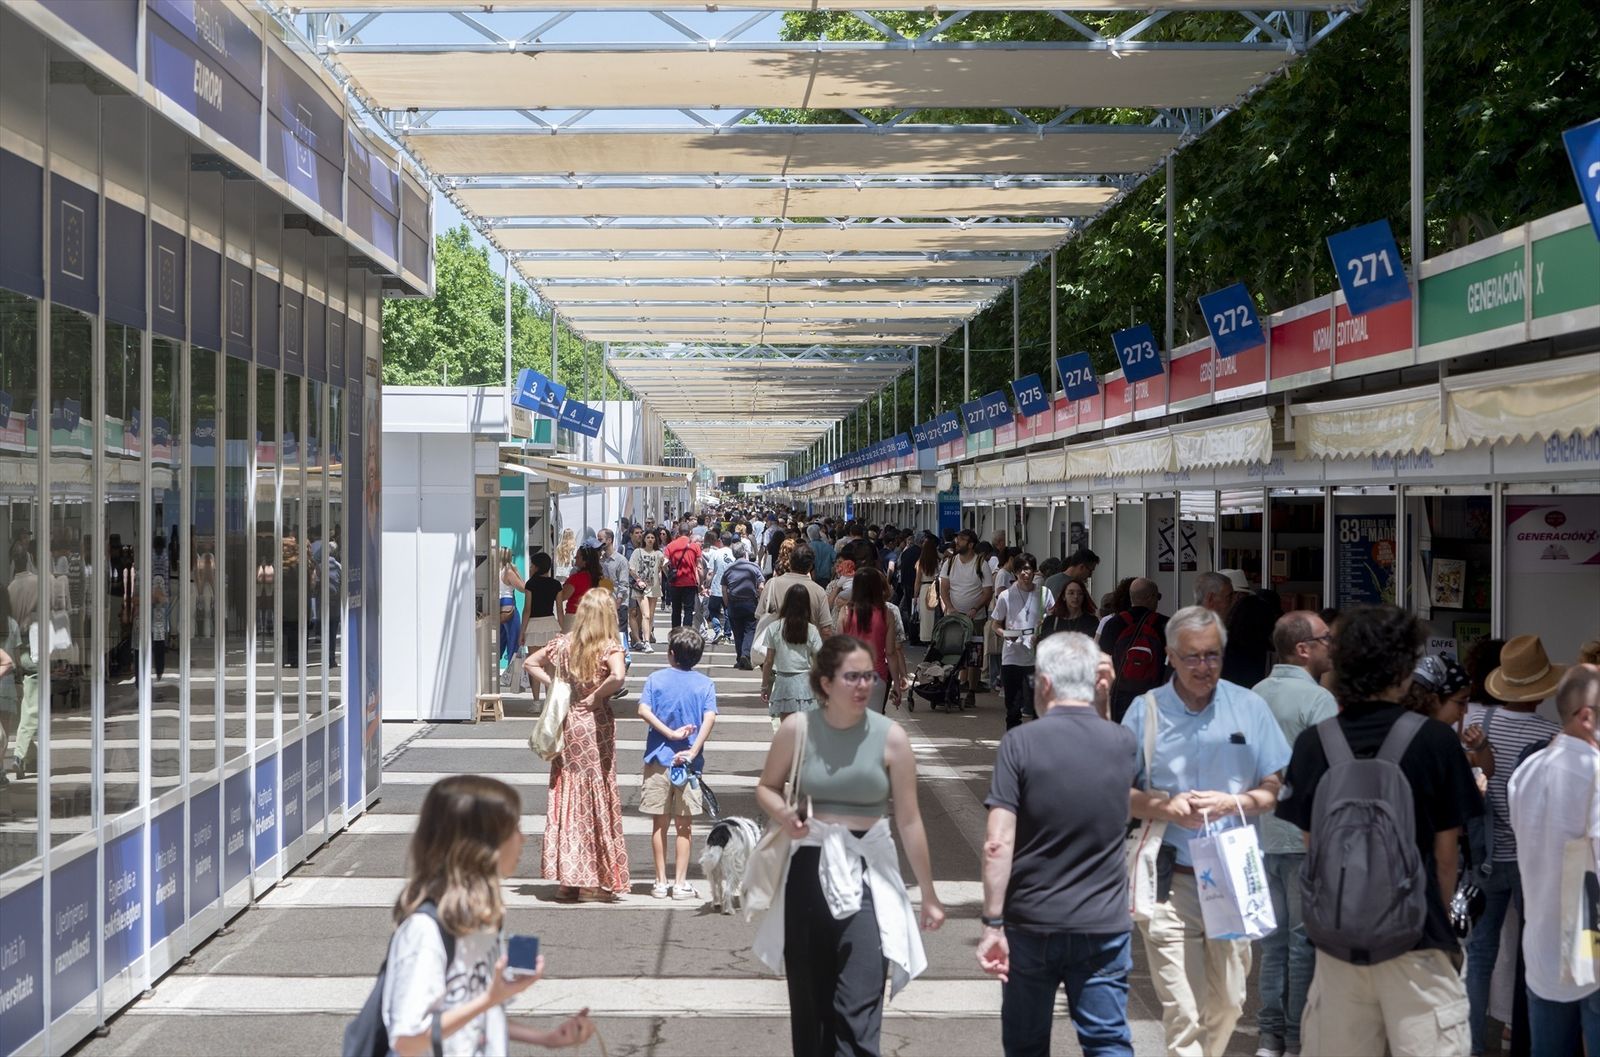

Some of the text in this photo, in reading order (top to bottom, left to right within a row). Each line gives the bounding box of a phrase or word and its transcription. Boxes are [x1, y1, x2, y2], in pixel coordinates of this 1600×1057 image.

[194, 59, 223, 112] EUROPA
[1347, 249, 1394, 288] 271
[1467, 261, 1544, 314] GENERACIÓN X
[1213, 305, 1253, 337] 272
[1313, 315, 1369, 353] NORMA EDITORIAL
[1123, 341, 1155, 366] 273
[1065, 367, 1093, 388] 274
[530, 381, 538, 394] 3
[547, 391, 555, 403] 3
[1019, 386, 1042, 406] 275
[570, 409, 577, 419] 4
[967, 408, 985, 424] 277
[986, 401, 1008, 418] 276
[588, 416, 595, 426] 4
[941, 419, 959, 433] 278
[914, 432, 927, 442] 28
[896, 440, 909, 451] 281
[1339, 518, 1360, 543] 83
[1360, 519, 1377, 528] FERIA
[1368, 527, 1397, 543] MADR
